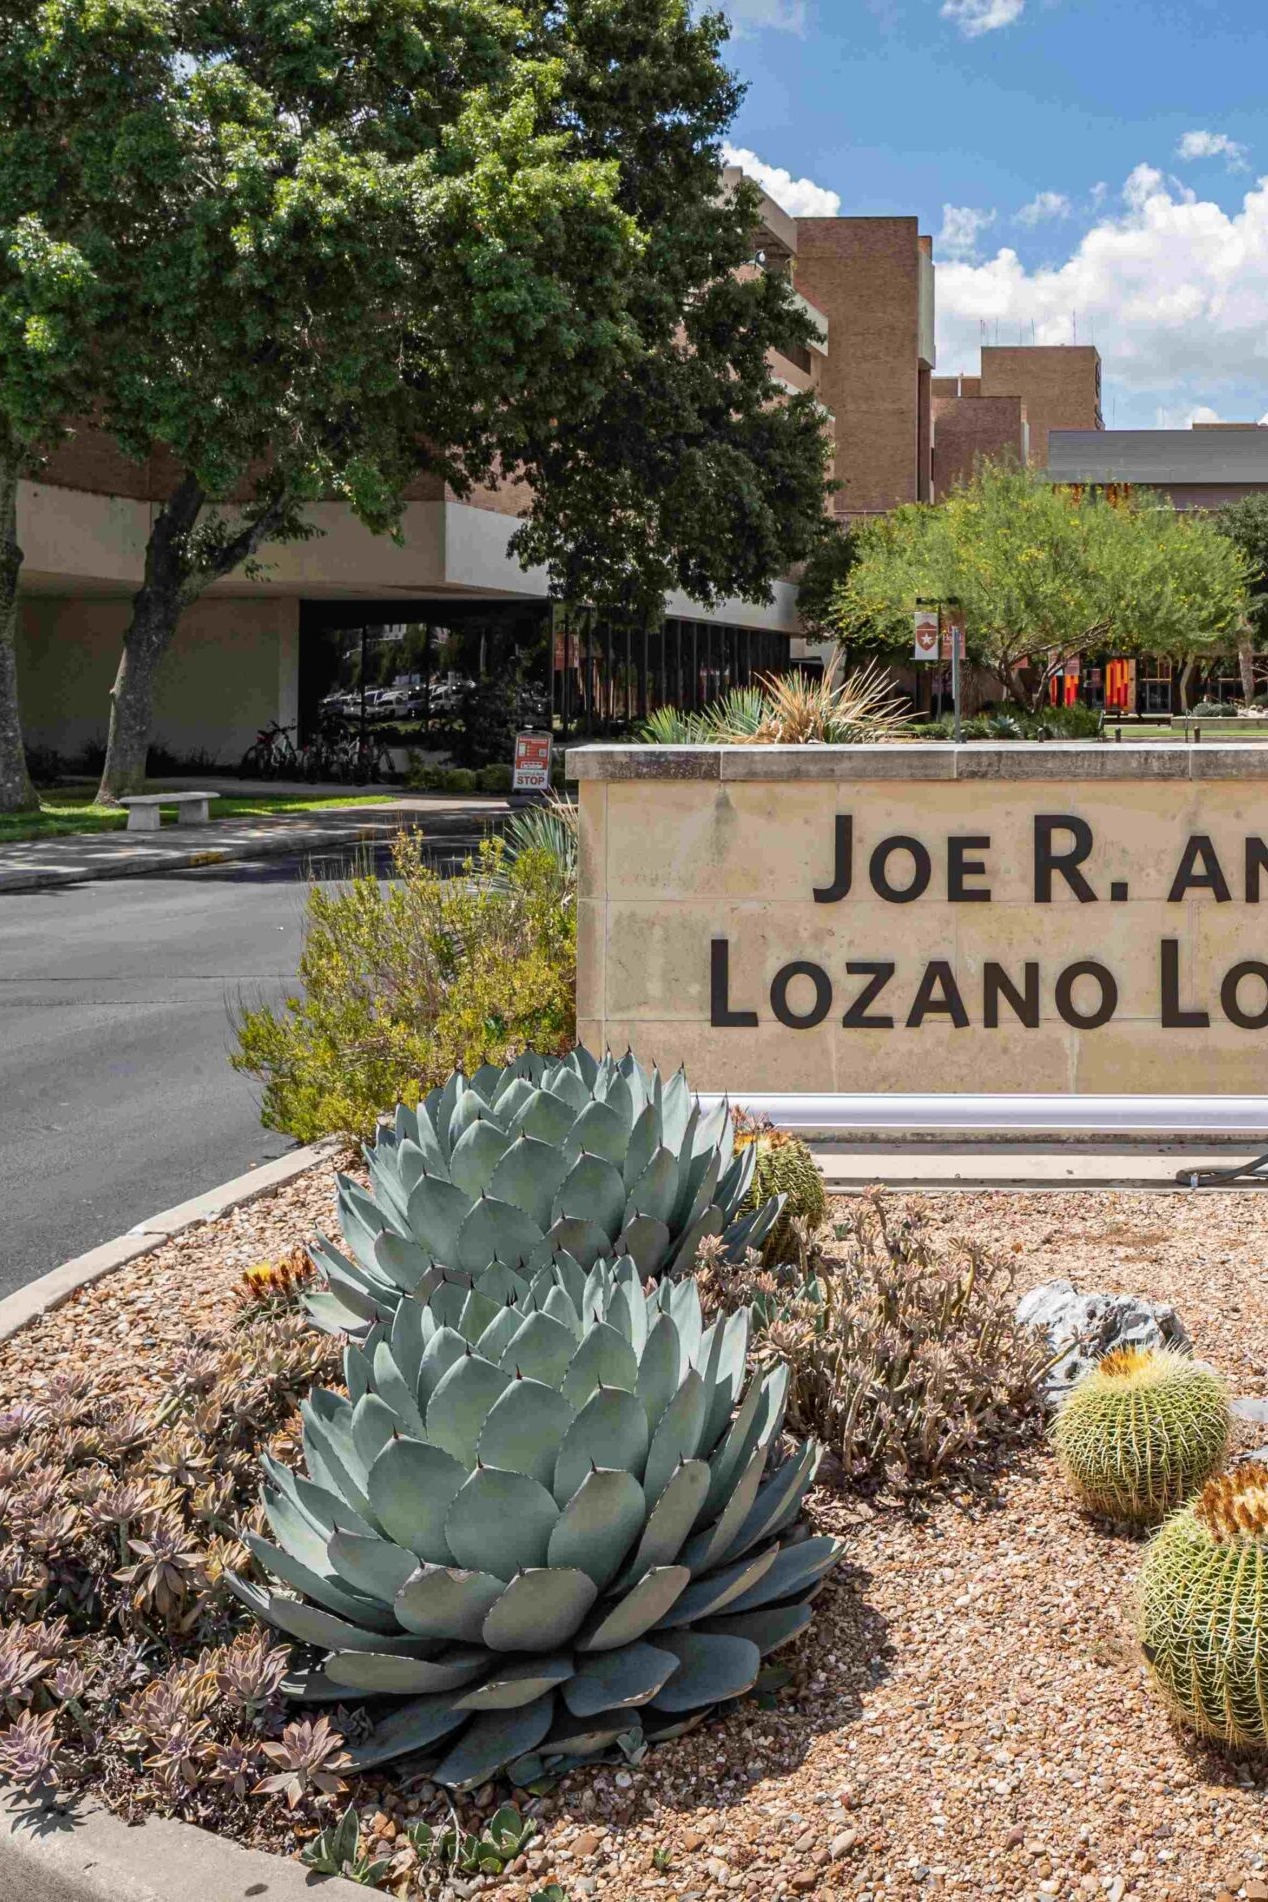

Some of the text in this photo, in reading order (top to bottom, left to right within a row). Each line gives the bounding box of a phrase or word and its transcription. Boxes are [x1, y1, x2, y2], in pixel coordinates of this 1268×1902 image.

[517, 776, 545, 785] STOP
[812, 813, 992, 905] JOE
[1034, 813, 1130, 905] R.
[709, 938, 1119, 1031] LOZANO
